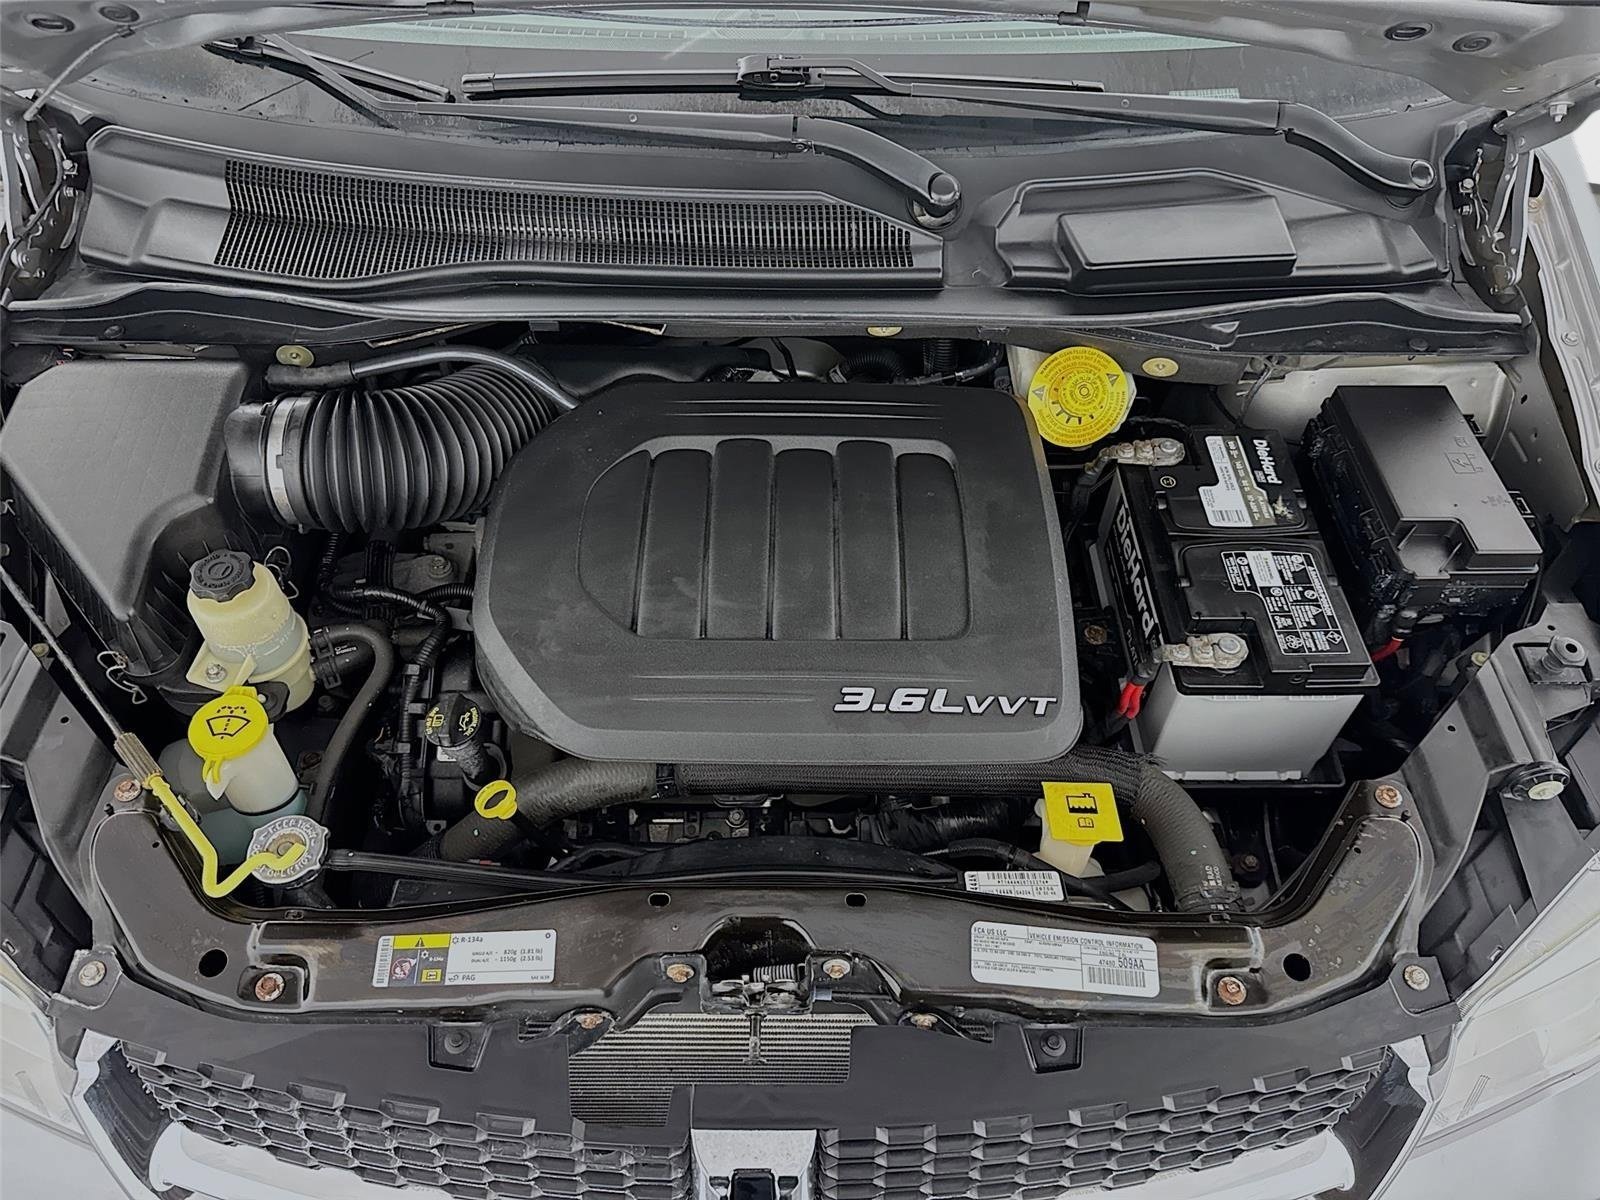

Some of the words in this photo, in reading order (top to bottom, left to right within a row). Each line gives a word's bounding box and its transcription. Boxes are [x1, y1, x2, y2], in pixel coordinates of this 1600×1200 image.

[1253, 440, 1282, 484] DieHard
[1116, 504, 1154, 638] DieHard
[1029, 932, 1051, 941] VEHICLE
[1053, 934, 1079, 943] EMISSION
[1080, 937, 1104, 945] CONTROL
[1106, 939, 1144, 950] INFORMATION
[1118, 958, 1145, 970] 509AA
